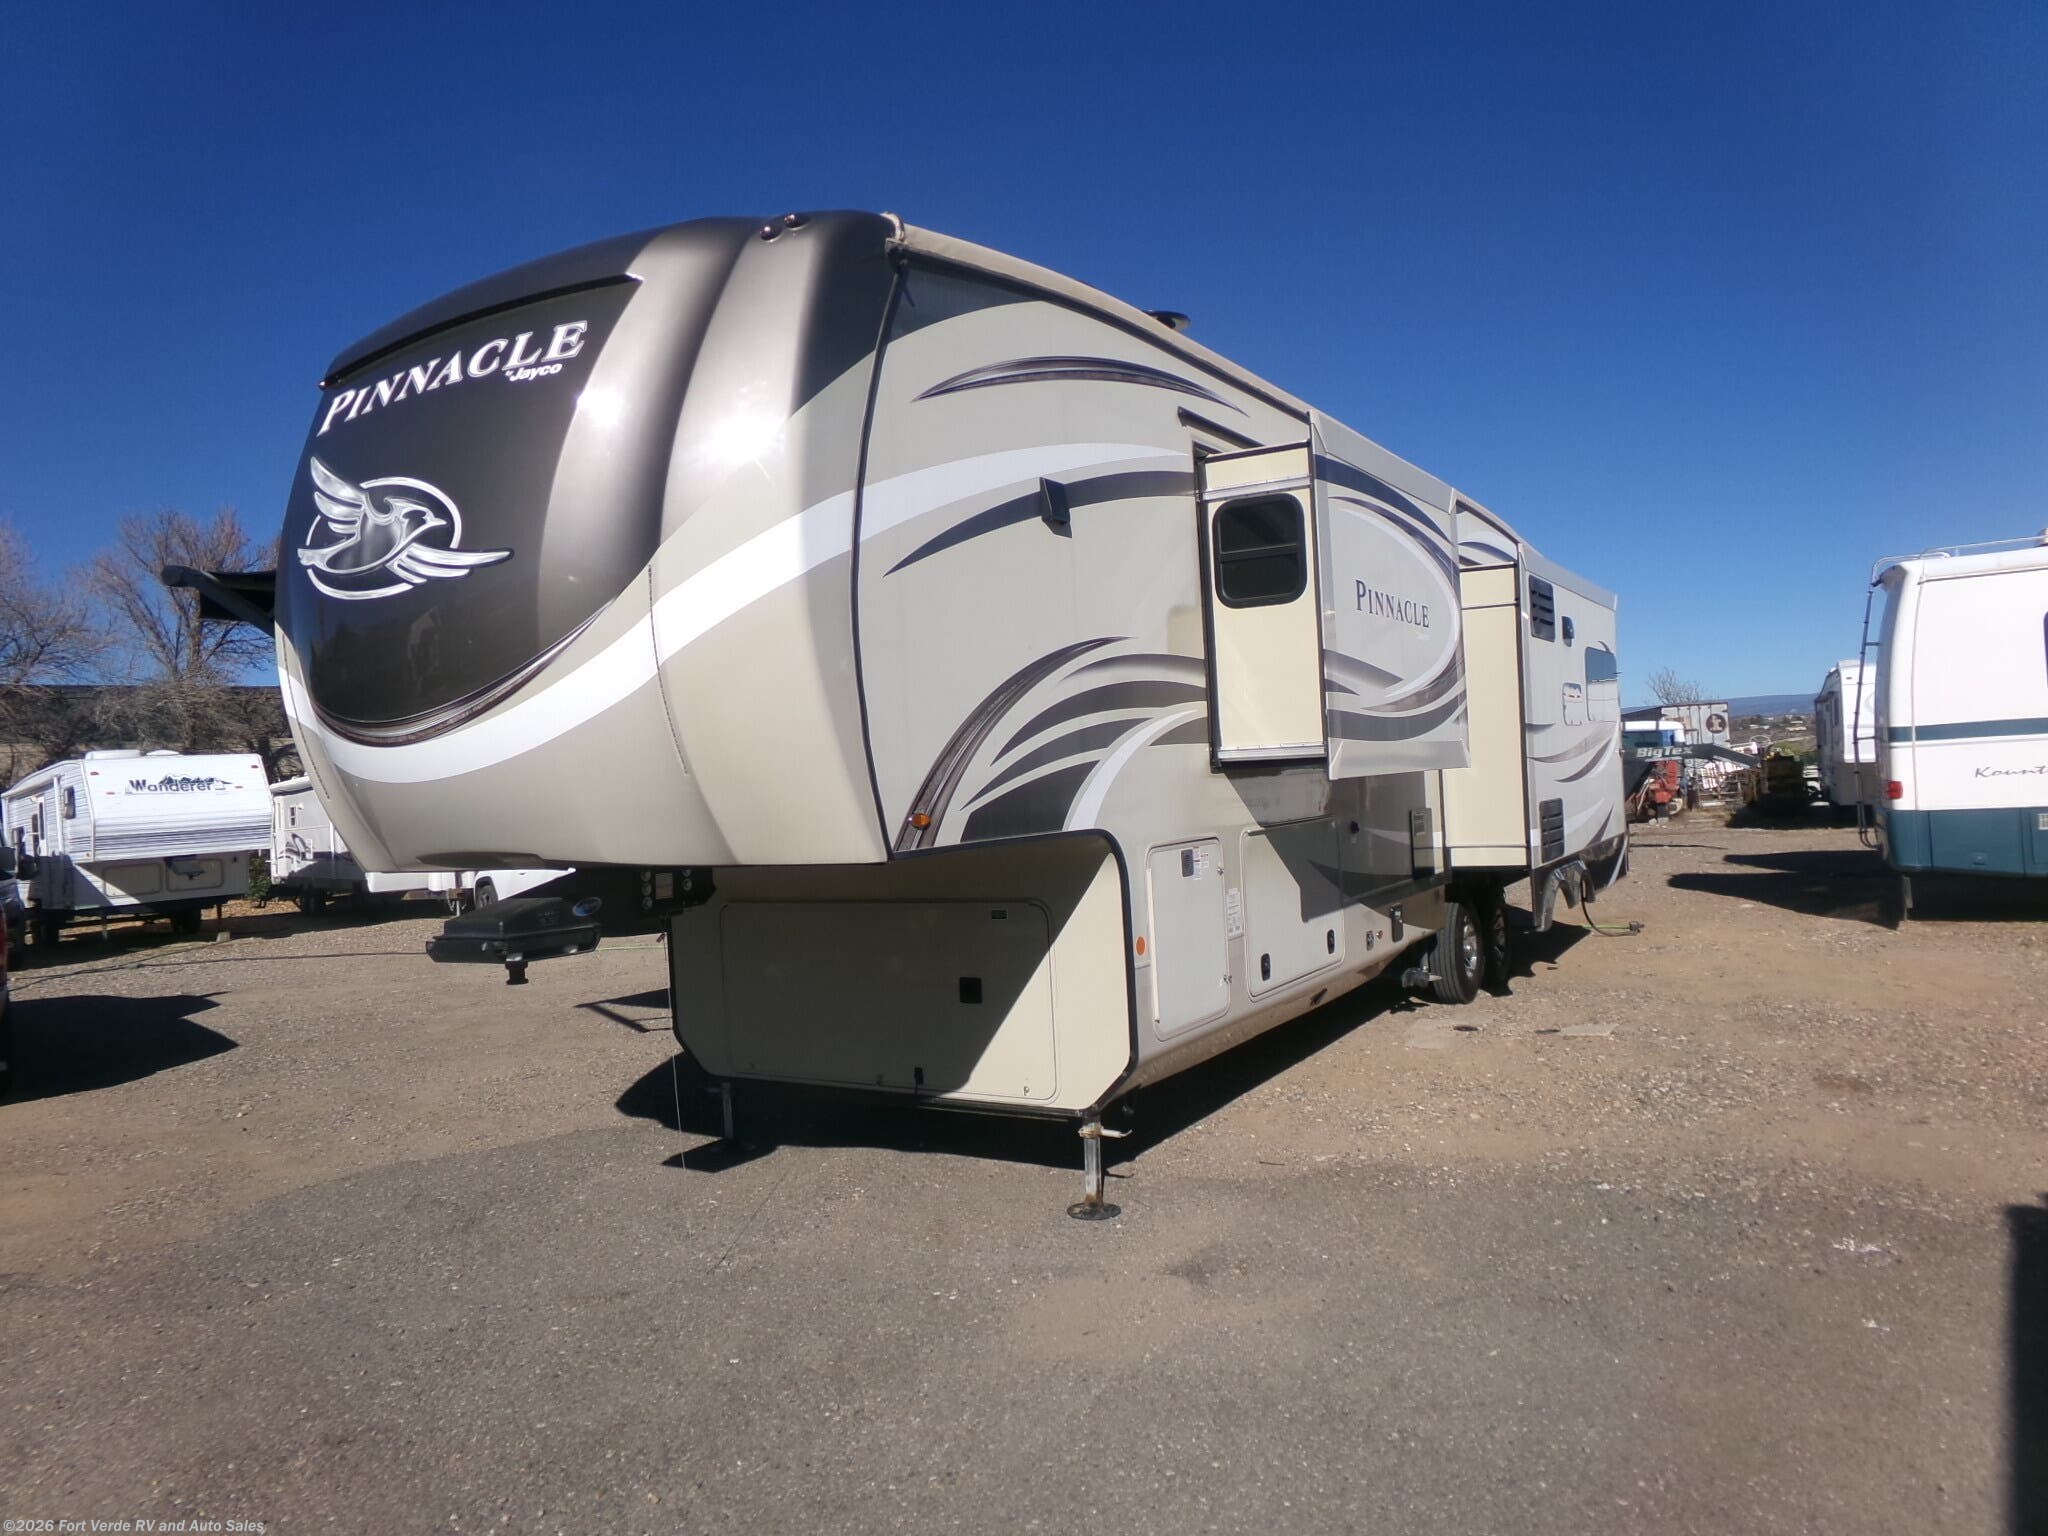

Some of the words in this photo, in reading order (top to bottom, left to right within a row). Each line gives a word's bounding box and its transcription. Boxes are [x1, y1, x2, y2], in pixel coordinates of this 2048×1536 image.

[316, 320, 588, 437] PINNACLE
[509, 363, 562, 381] Jayco
[1355, 579, 1430, 628] PINNACLE
[128, 778, 213, 792] Wanderer
